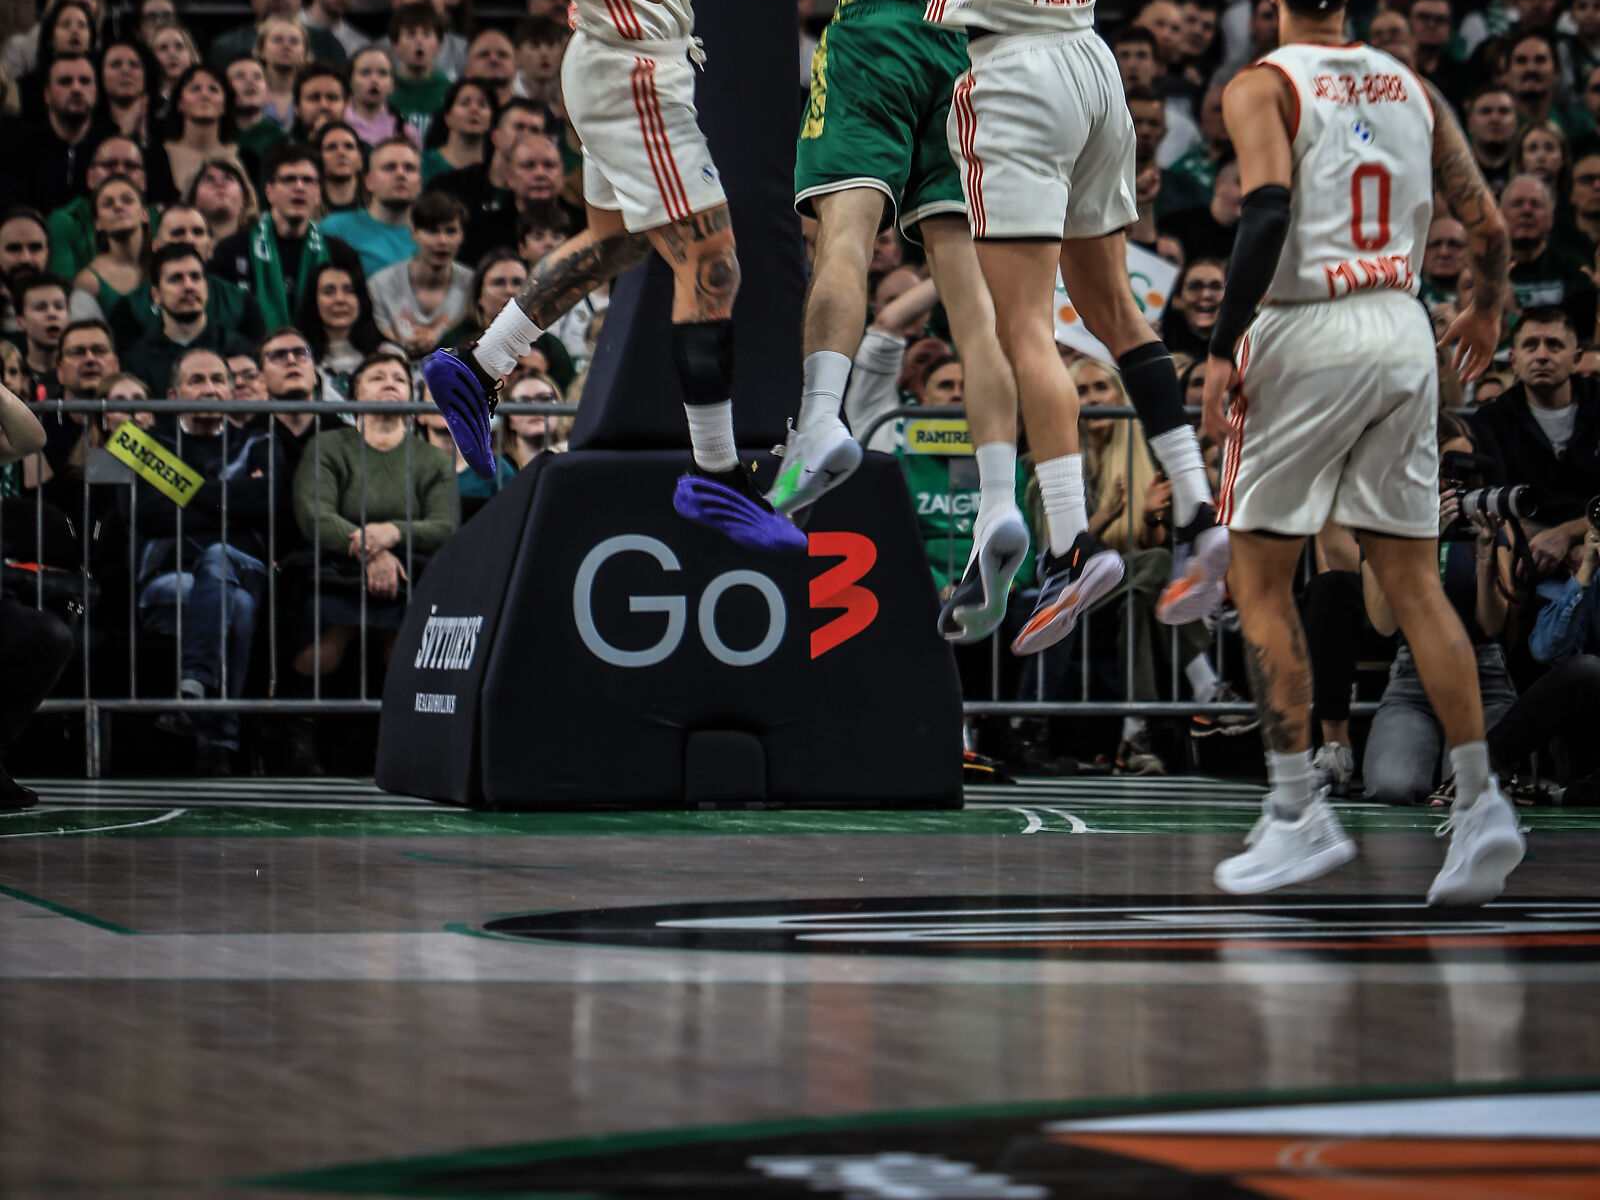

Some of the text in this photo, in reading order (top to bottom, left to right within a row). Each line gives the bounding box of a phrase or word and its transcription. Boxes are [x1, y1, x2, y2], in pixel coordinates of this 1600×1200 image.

[1351, 161, 1391, 252] 0
[115, 430, 194, 494] RAMIRENT
[916, 430, 971, 444] RAMIRE
